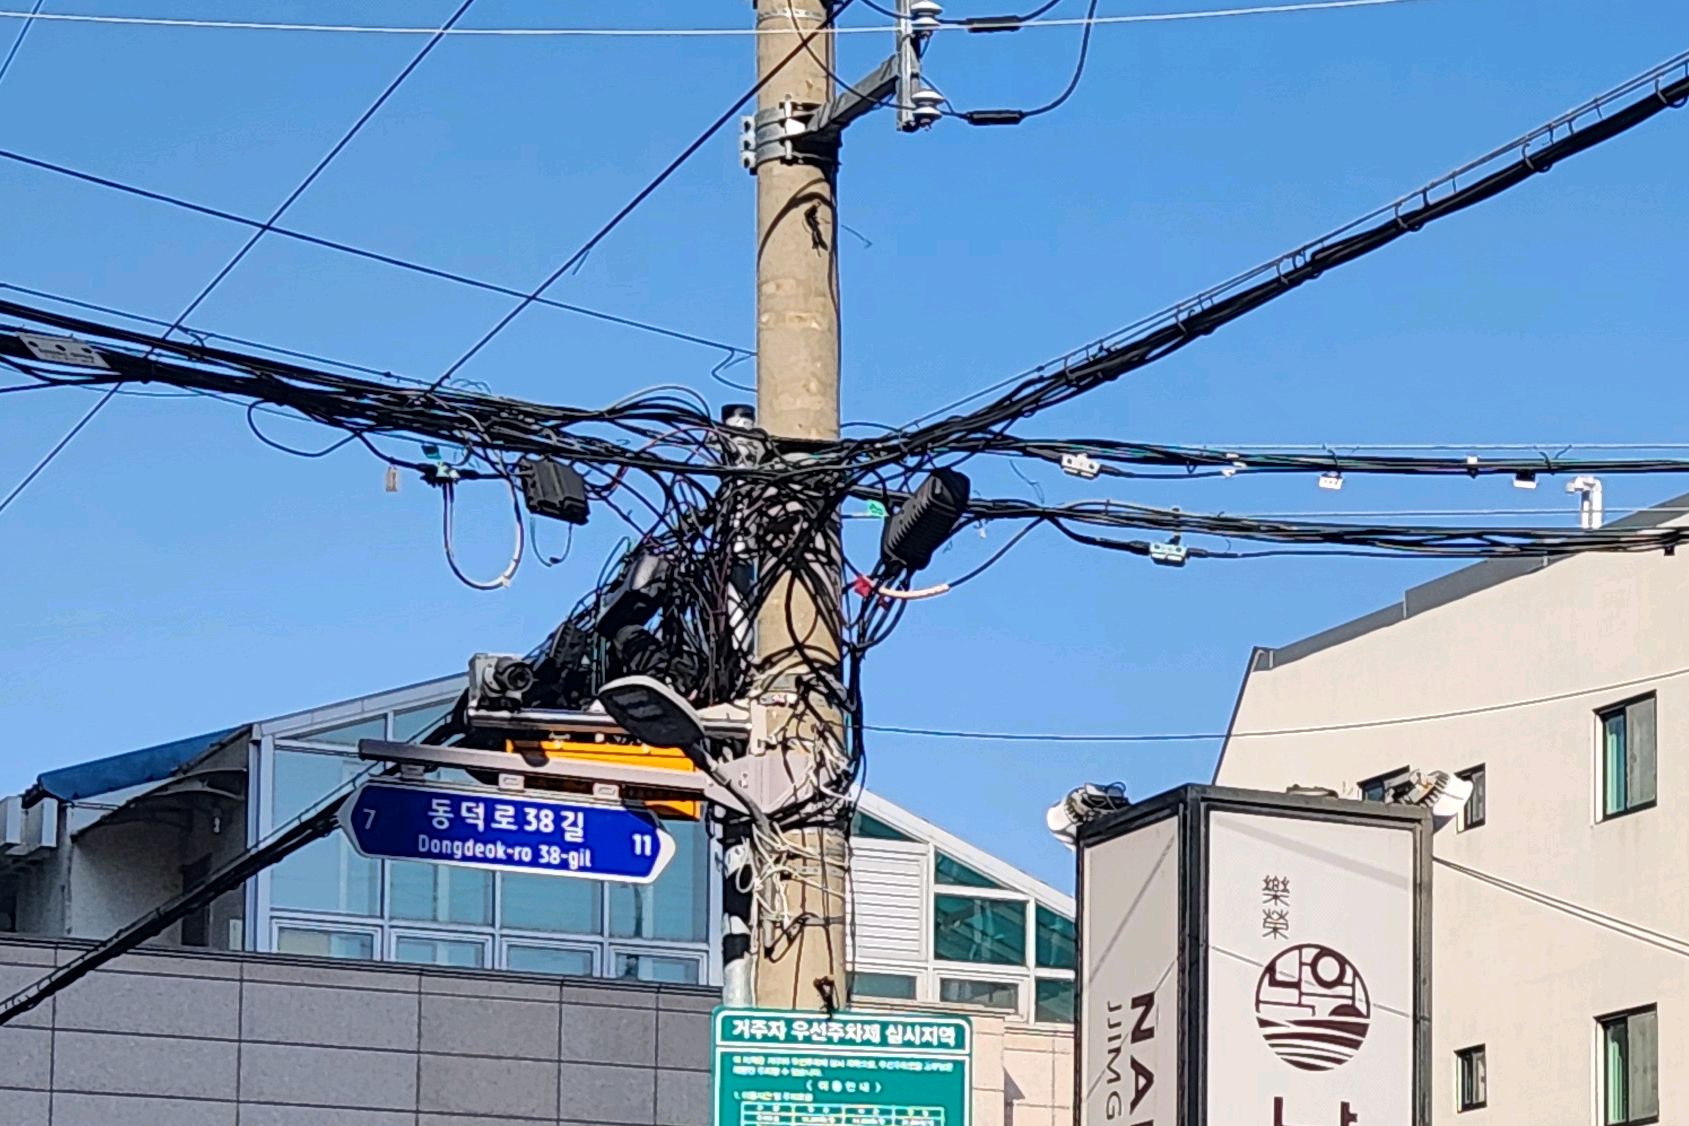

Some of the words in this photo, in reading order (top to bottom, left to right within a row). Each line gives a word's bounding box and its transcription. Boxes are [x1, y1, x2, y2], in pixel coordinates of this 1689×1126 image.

[362, 808, 377, 830] 7
[427, 798, 585, 843] 동덕로38길
[417, 834, 532, 863] Dongdeok-ro
[538, 843, 592, 870] 38-gil
[631, 833, 652, 856] 11
[732, 1019, 787, 1041] 거주자
[790, 1021, 881, 1044] 우선주차제
